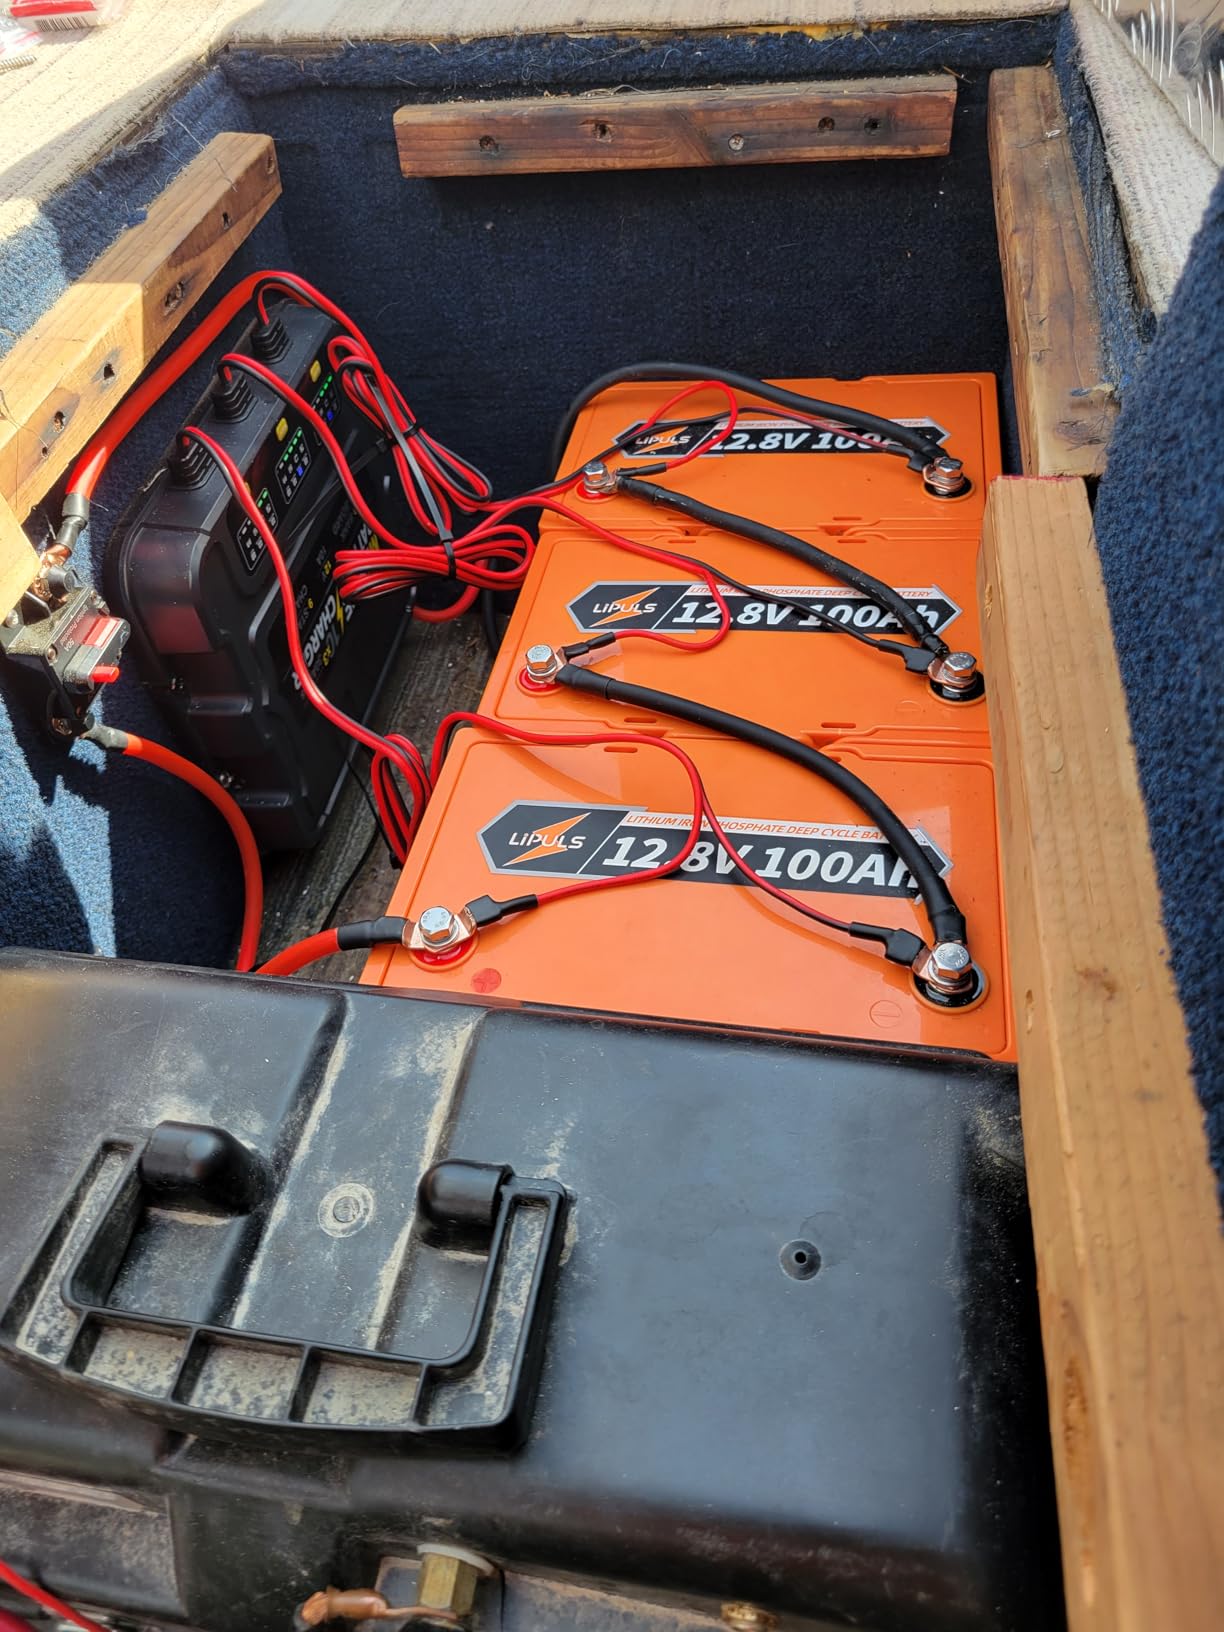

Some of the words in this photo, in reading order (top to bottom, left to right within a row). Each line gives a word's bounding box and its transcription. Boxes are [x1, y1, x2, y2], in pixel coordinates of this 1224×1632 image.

[291, 594, 336, 690] CHARGR
[626, 815, 678, 826] LITHIUM
[680, 818, 709, 829] IRN
[718, 820, 785, 833] HOSPHATE
[786, 825, 820, 835] DEEP
[822, 827, 859, 838] CYCLE
[602, 836, 754, 875] 128V
